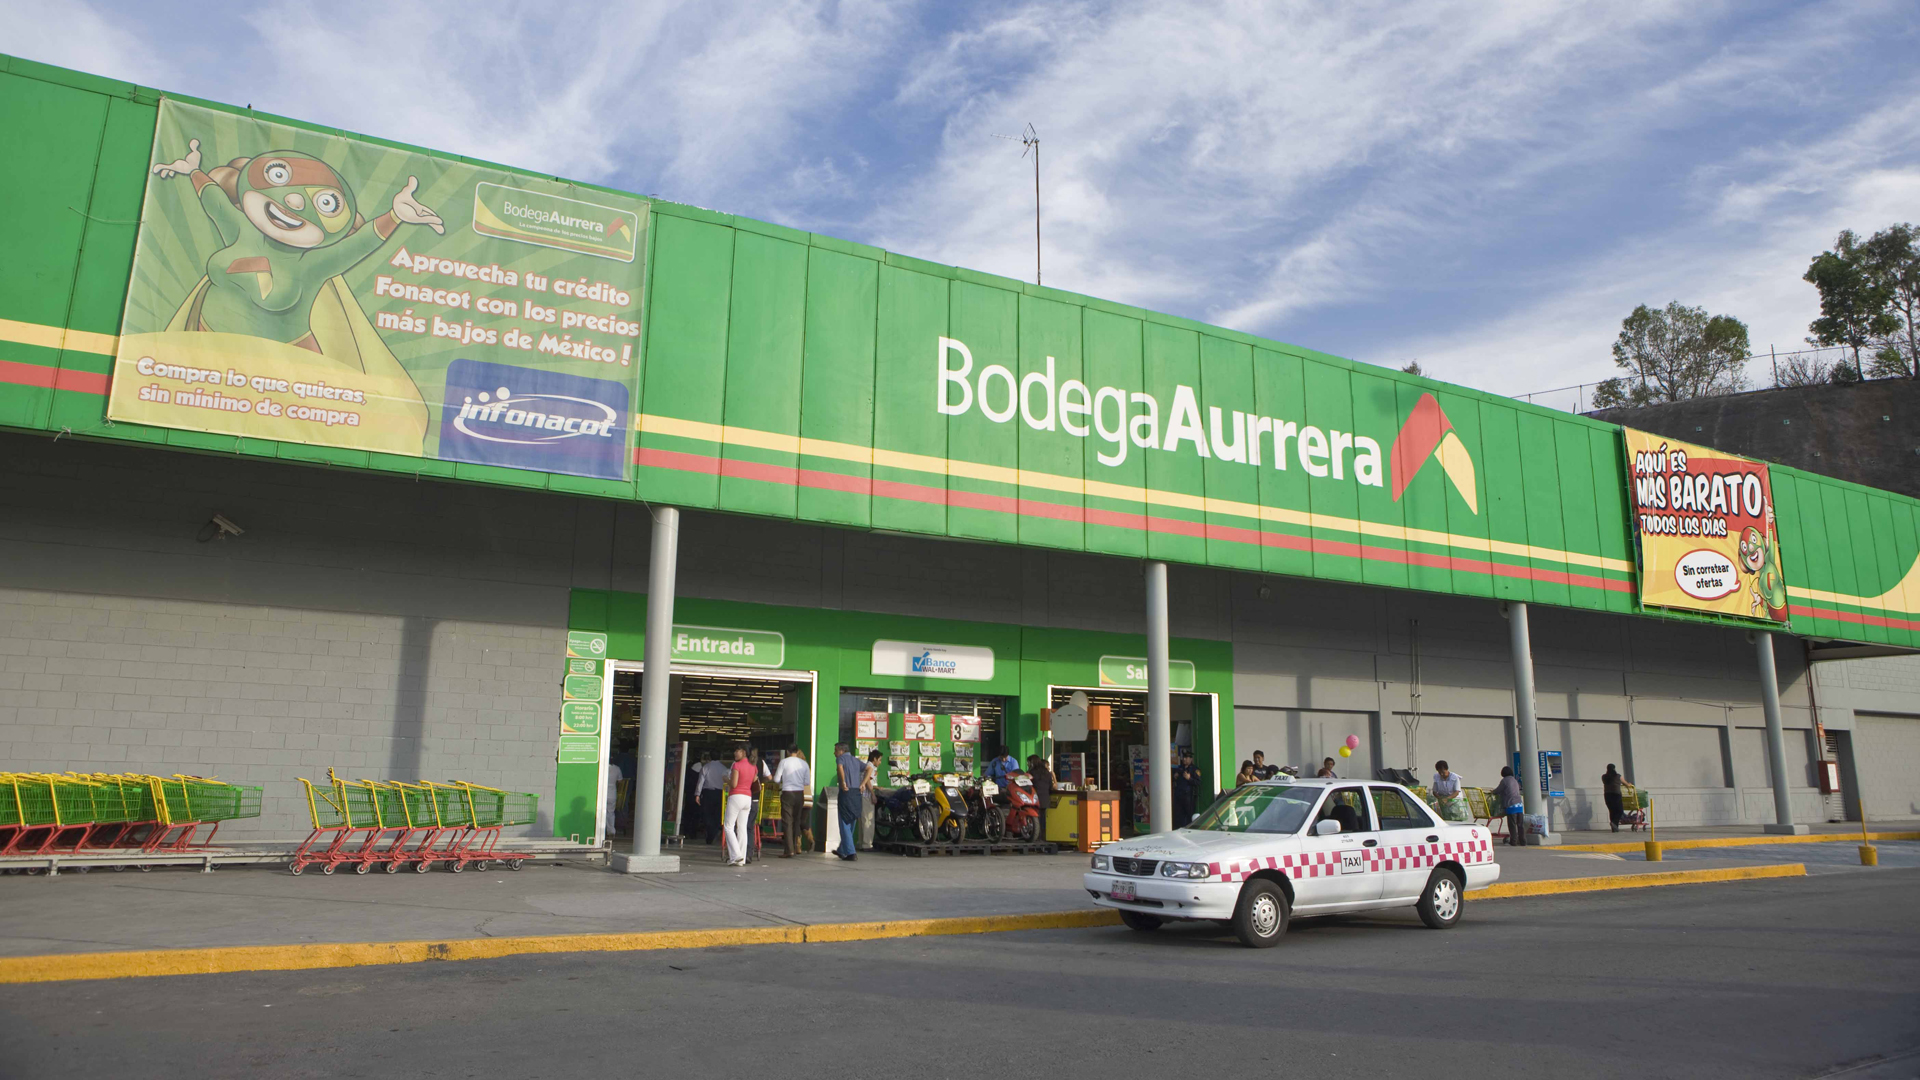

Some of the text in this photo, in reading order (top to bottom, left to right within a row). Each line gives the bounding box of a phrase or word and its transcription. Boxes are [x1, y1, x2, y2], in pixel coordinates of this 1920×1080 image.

[570, 231, 588, 239] precios
[588, 233, 603, 242] bajos
[391, 247, 631, 306] Aprovecha tu crédito
[375, 276, 640, 336] Fonacot con los precios
[377, 310, 426, 333] más
[432, 316, 498, 344] bajos
[503, 329, 533, 350] de
[538, 334, 617, 363] México
[137, 357, 368, 405] Compra lo que quieras,
[138, 384, 360, 426] sin mínimo de compra
[459, 396, 616, 437] infonacot
[1636, 443, 1687, 473] AQUÍ ES
[1669, 473, 1762, 517] BARATO
[1640, 512, 1727, 536] TODOS LOS DÍAS
[1682, 564, 1730, 576] Sin corretear
[1696, 578, 1723, 589] ofertas
[677, 633, 755, 656] Entrada
[926, 657, 956, 668] Banco
[1126, 664, 1148, 680] Sal
[916, 723, 926, 739] 2
[954, 724, 962, 740] 3
[1343, 857, 1362, 867] TAXI
